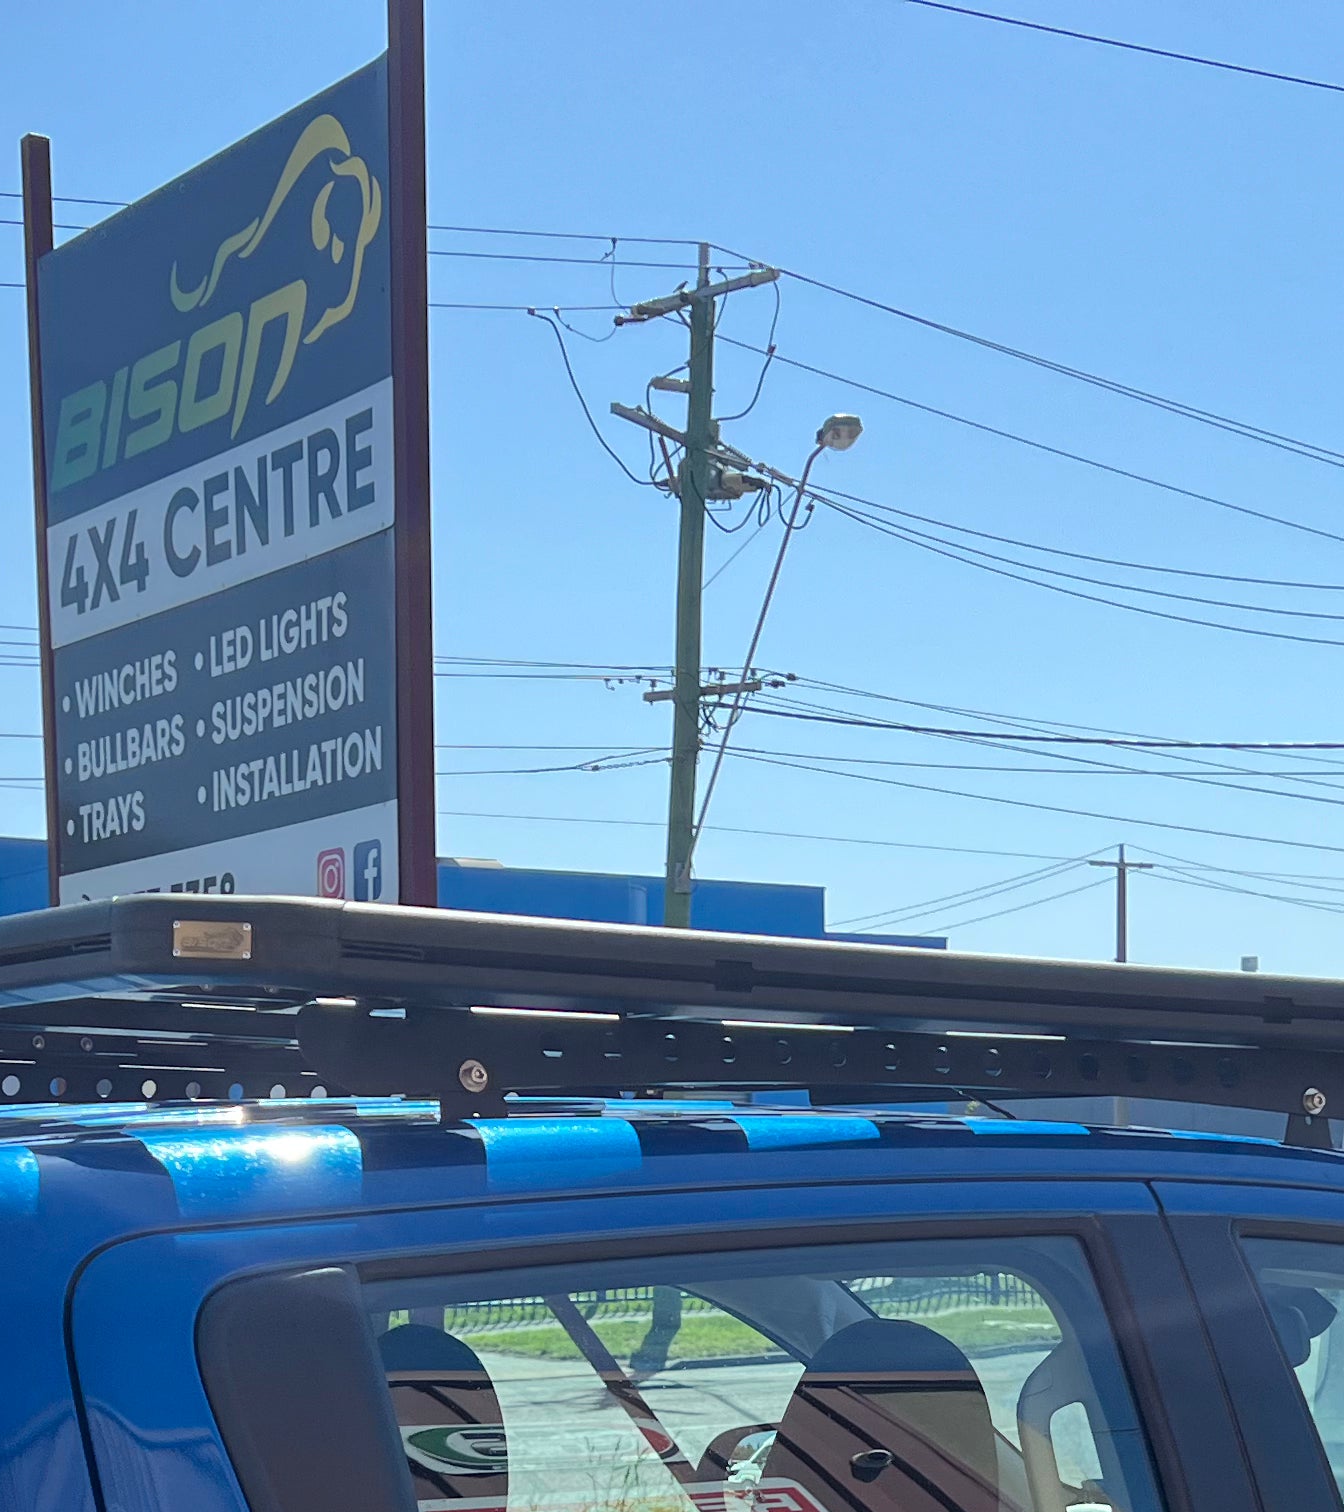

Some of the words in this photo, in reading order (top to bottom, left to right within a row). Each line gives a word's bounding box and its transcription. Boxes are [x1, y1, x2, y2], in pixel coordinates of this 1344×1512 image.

[52, 279, 308, 492] BISON
[60, 508, 150, 615] 4X4
[163, 406, 375, 577] CENTRE
[210, 625, 253, 677] LED
[259, 591, 348, 661] LIGHTS
[74, 650, 177, 718] WINCHES
[211, 658, 365, 745] SUSPENSION
[77, 714, 185, 782] BULLBARS
[212, 726, 382, 812] INSTALLATION
[79, 790, 145, 844] TRAYS
